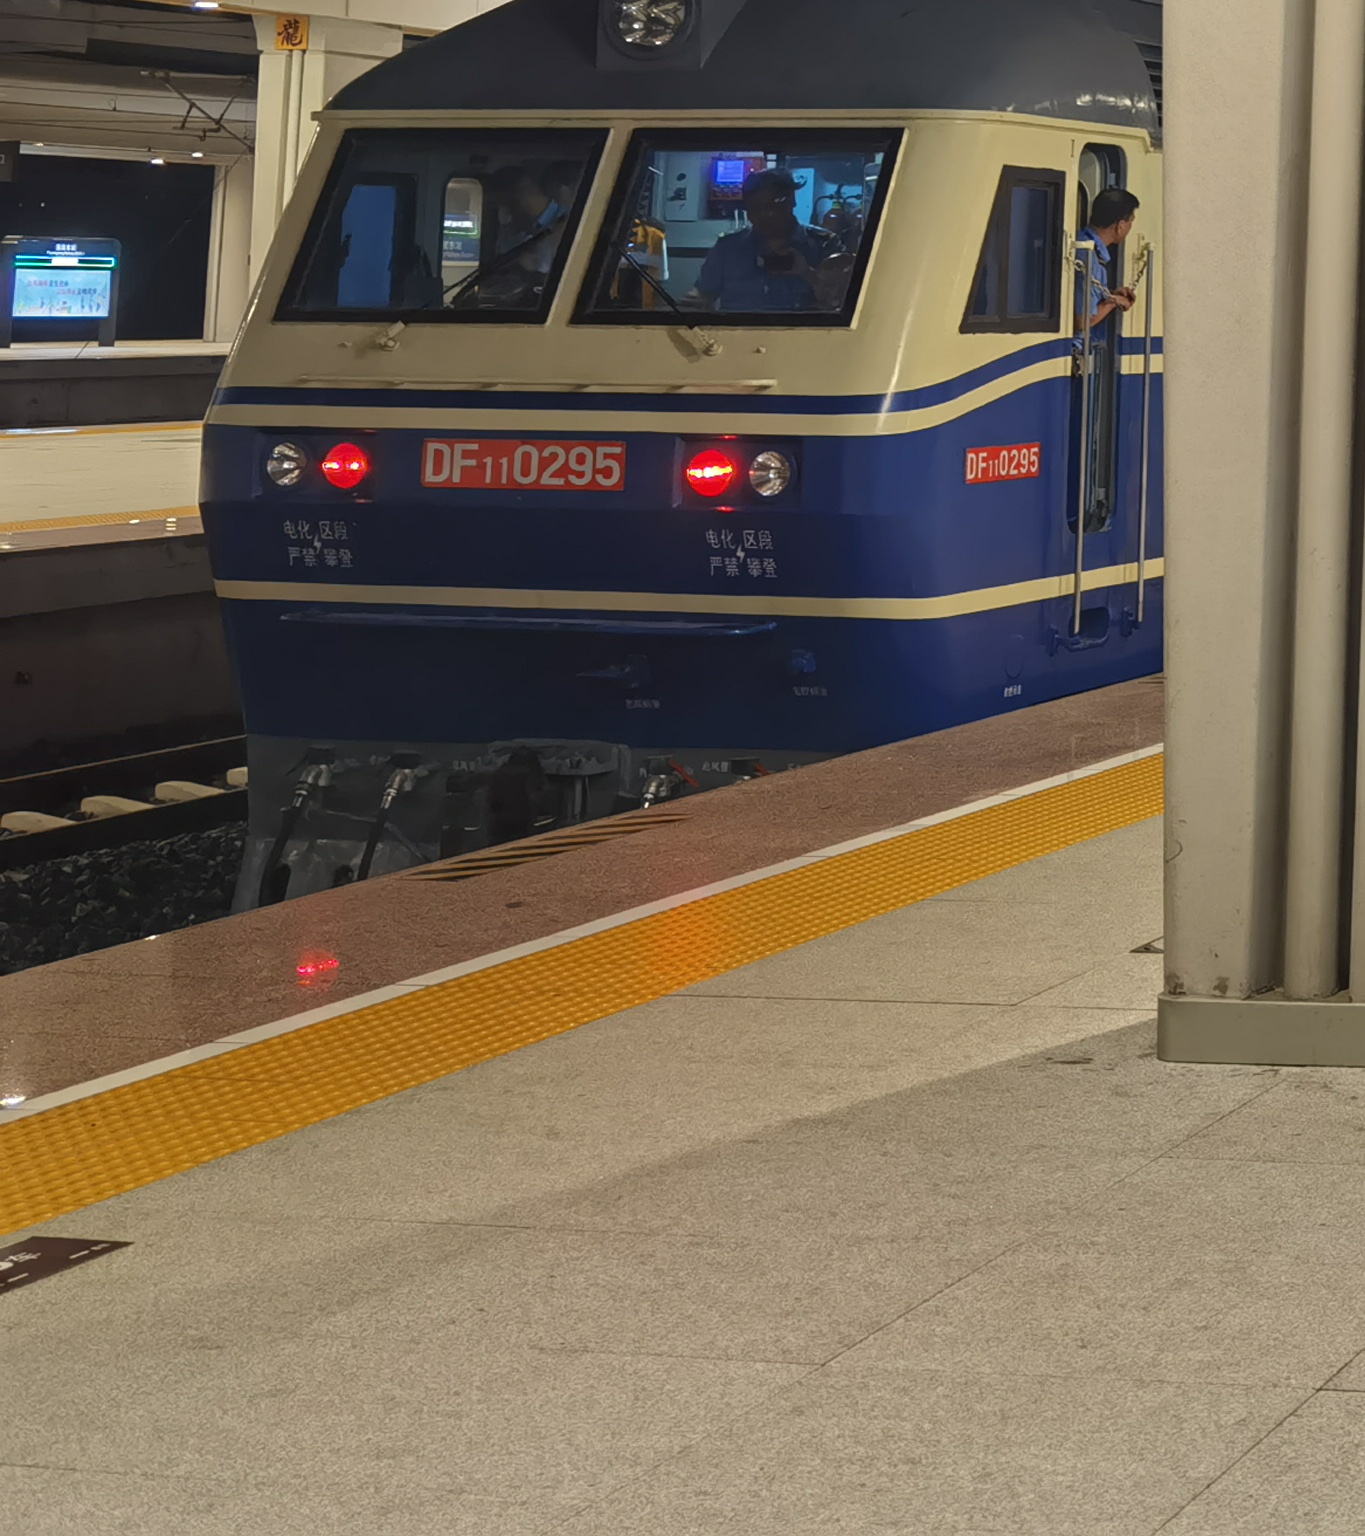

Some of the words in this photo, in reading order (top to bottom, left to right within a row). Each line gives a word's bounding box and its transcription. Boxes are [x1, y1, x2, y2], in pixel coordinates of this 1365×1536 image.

[705, 529, 736, 549] 电化
[743, 530, 773, 550] 区段
[709, 556, 740, 577] 严禁
